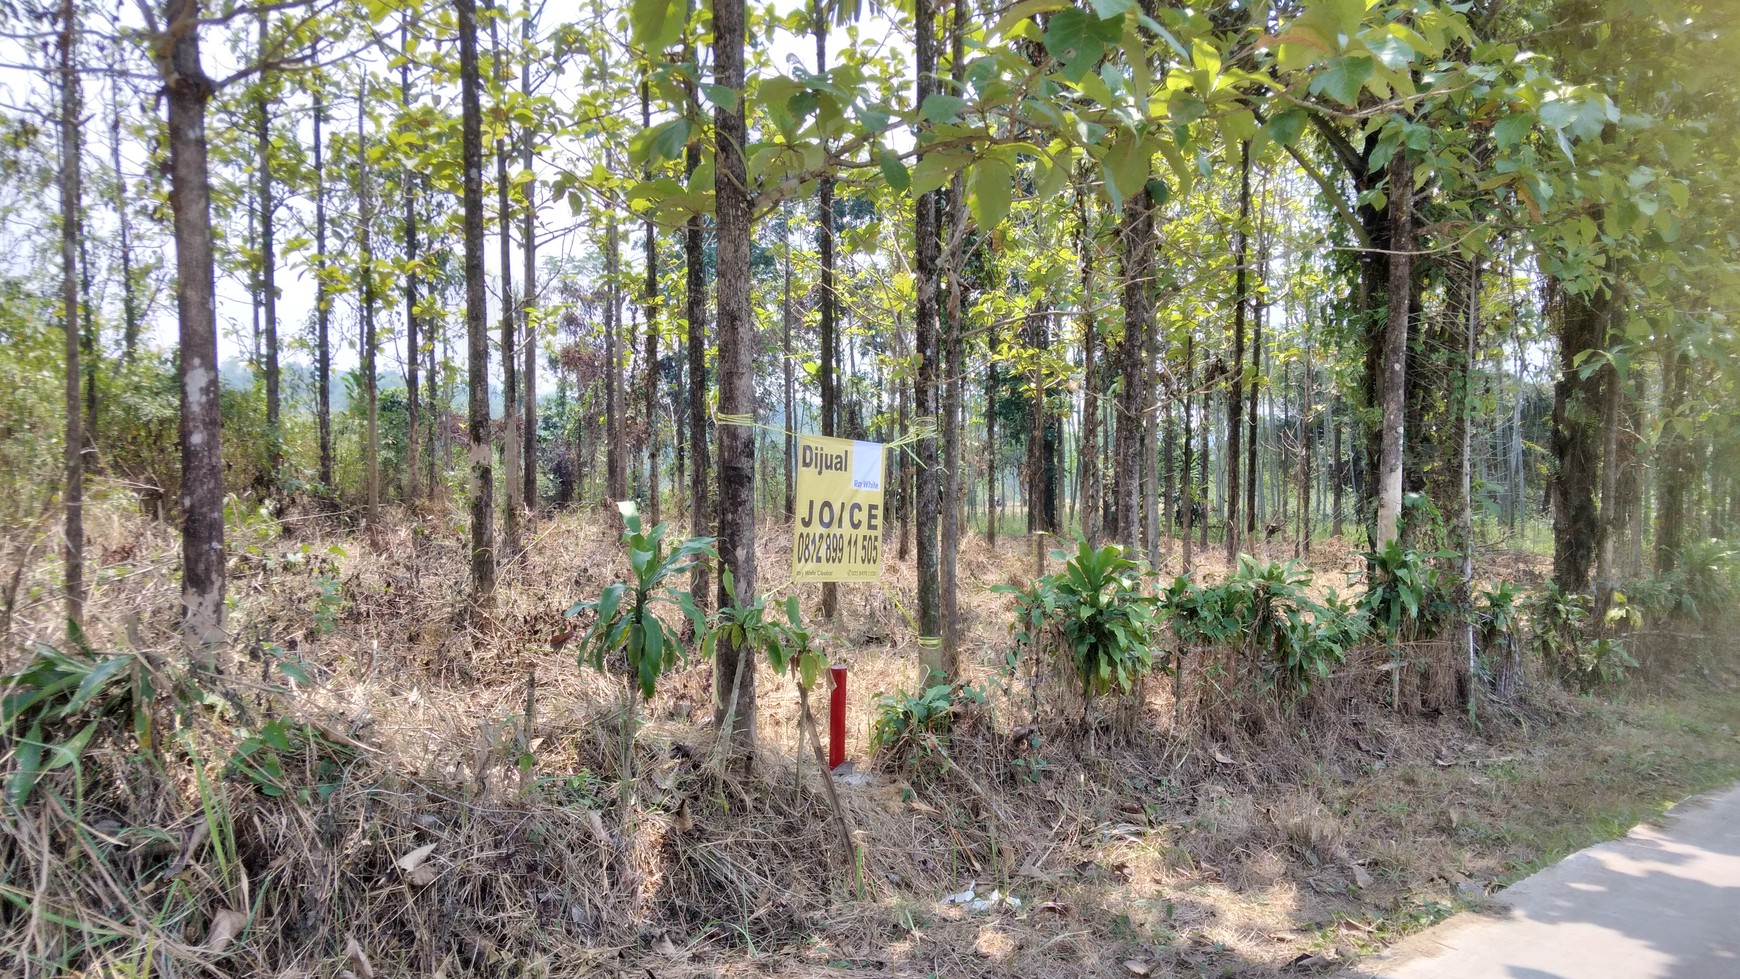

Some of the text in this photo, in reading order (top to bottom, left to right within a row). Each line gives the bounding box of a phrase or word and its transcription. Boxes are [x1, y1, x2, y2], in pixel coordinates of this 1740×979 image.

[802, 444, 848, 476] Dijual
[801, 500, 879, 531] JOICE
[798, 532, 879, 565] 0812 899 11 505
